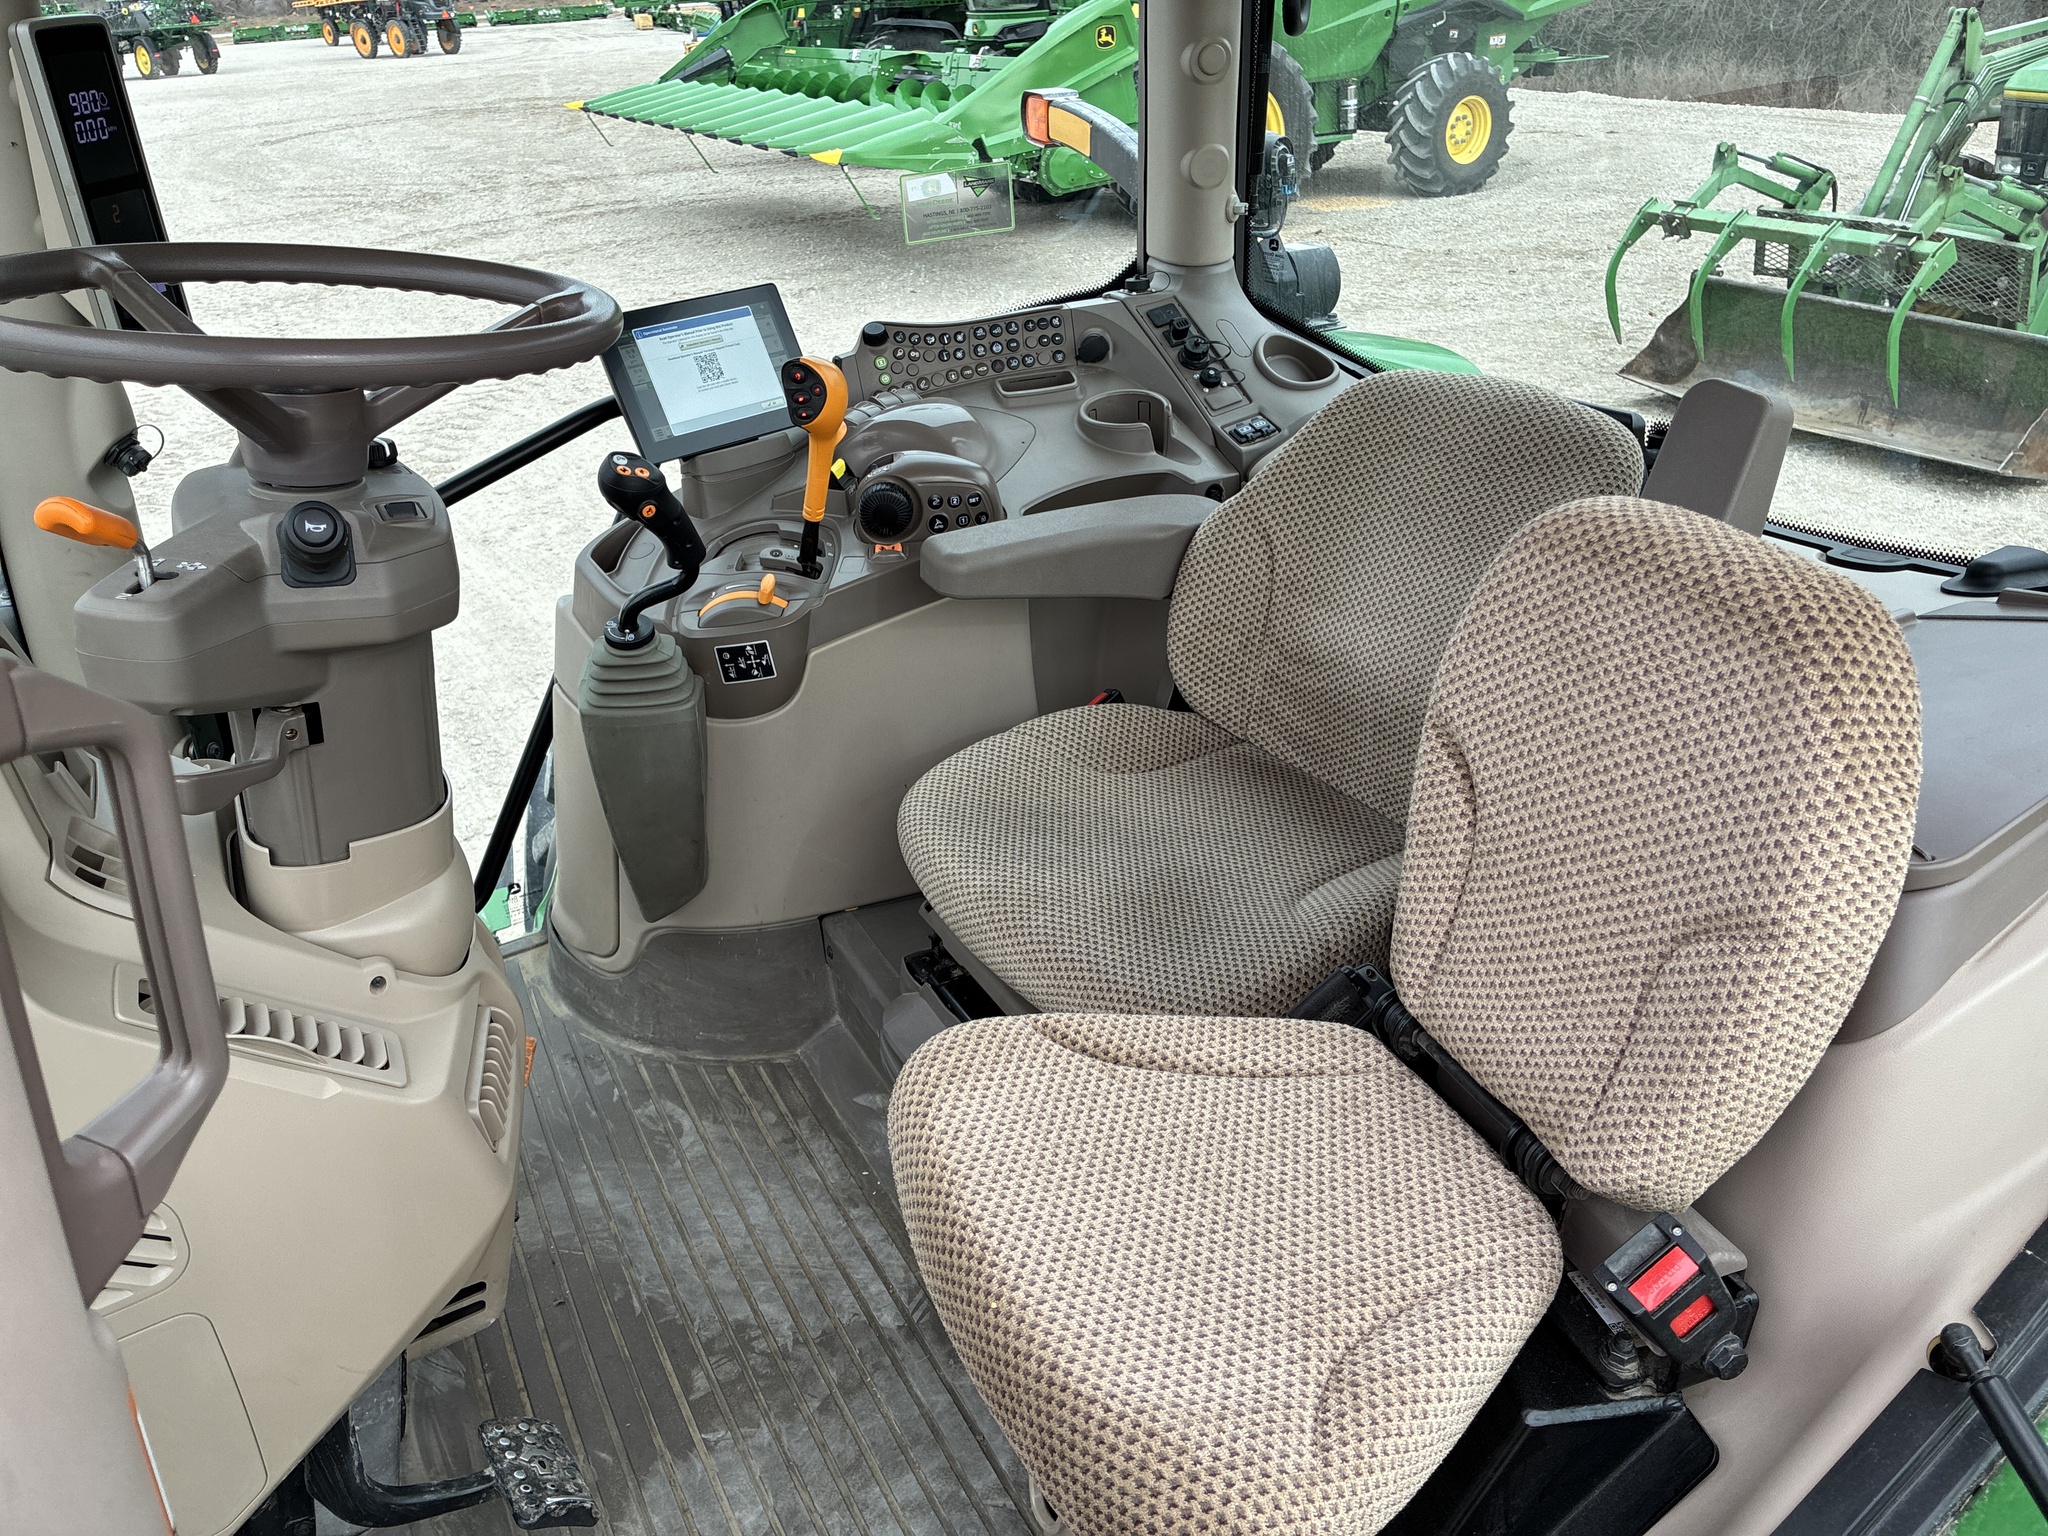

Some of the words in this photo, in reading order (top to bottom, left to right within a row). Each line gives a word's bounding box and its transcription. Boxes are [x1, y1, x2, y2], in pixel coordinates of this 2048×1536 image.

[69, 90, 101, 116] 980
[74, 117, 109, 144] 0.00
[111, 204, 121, 224] 2
